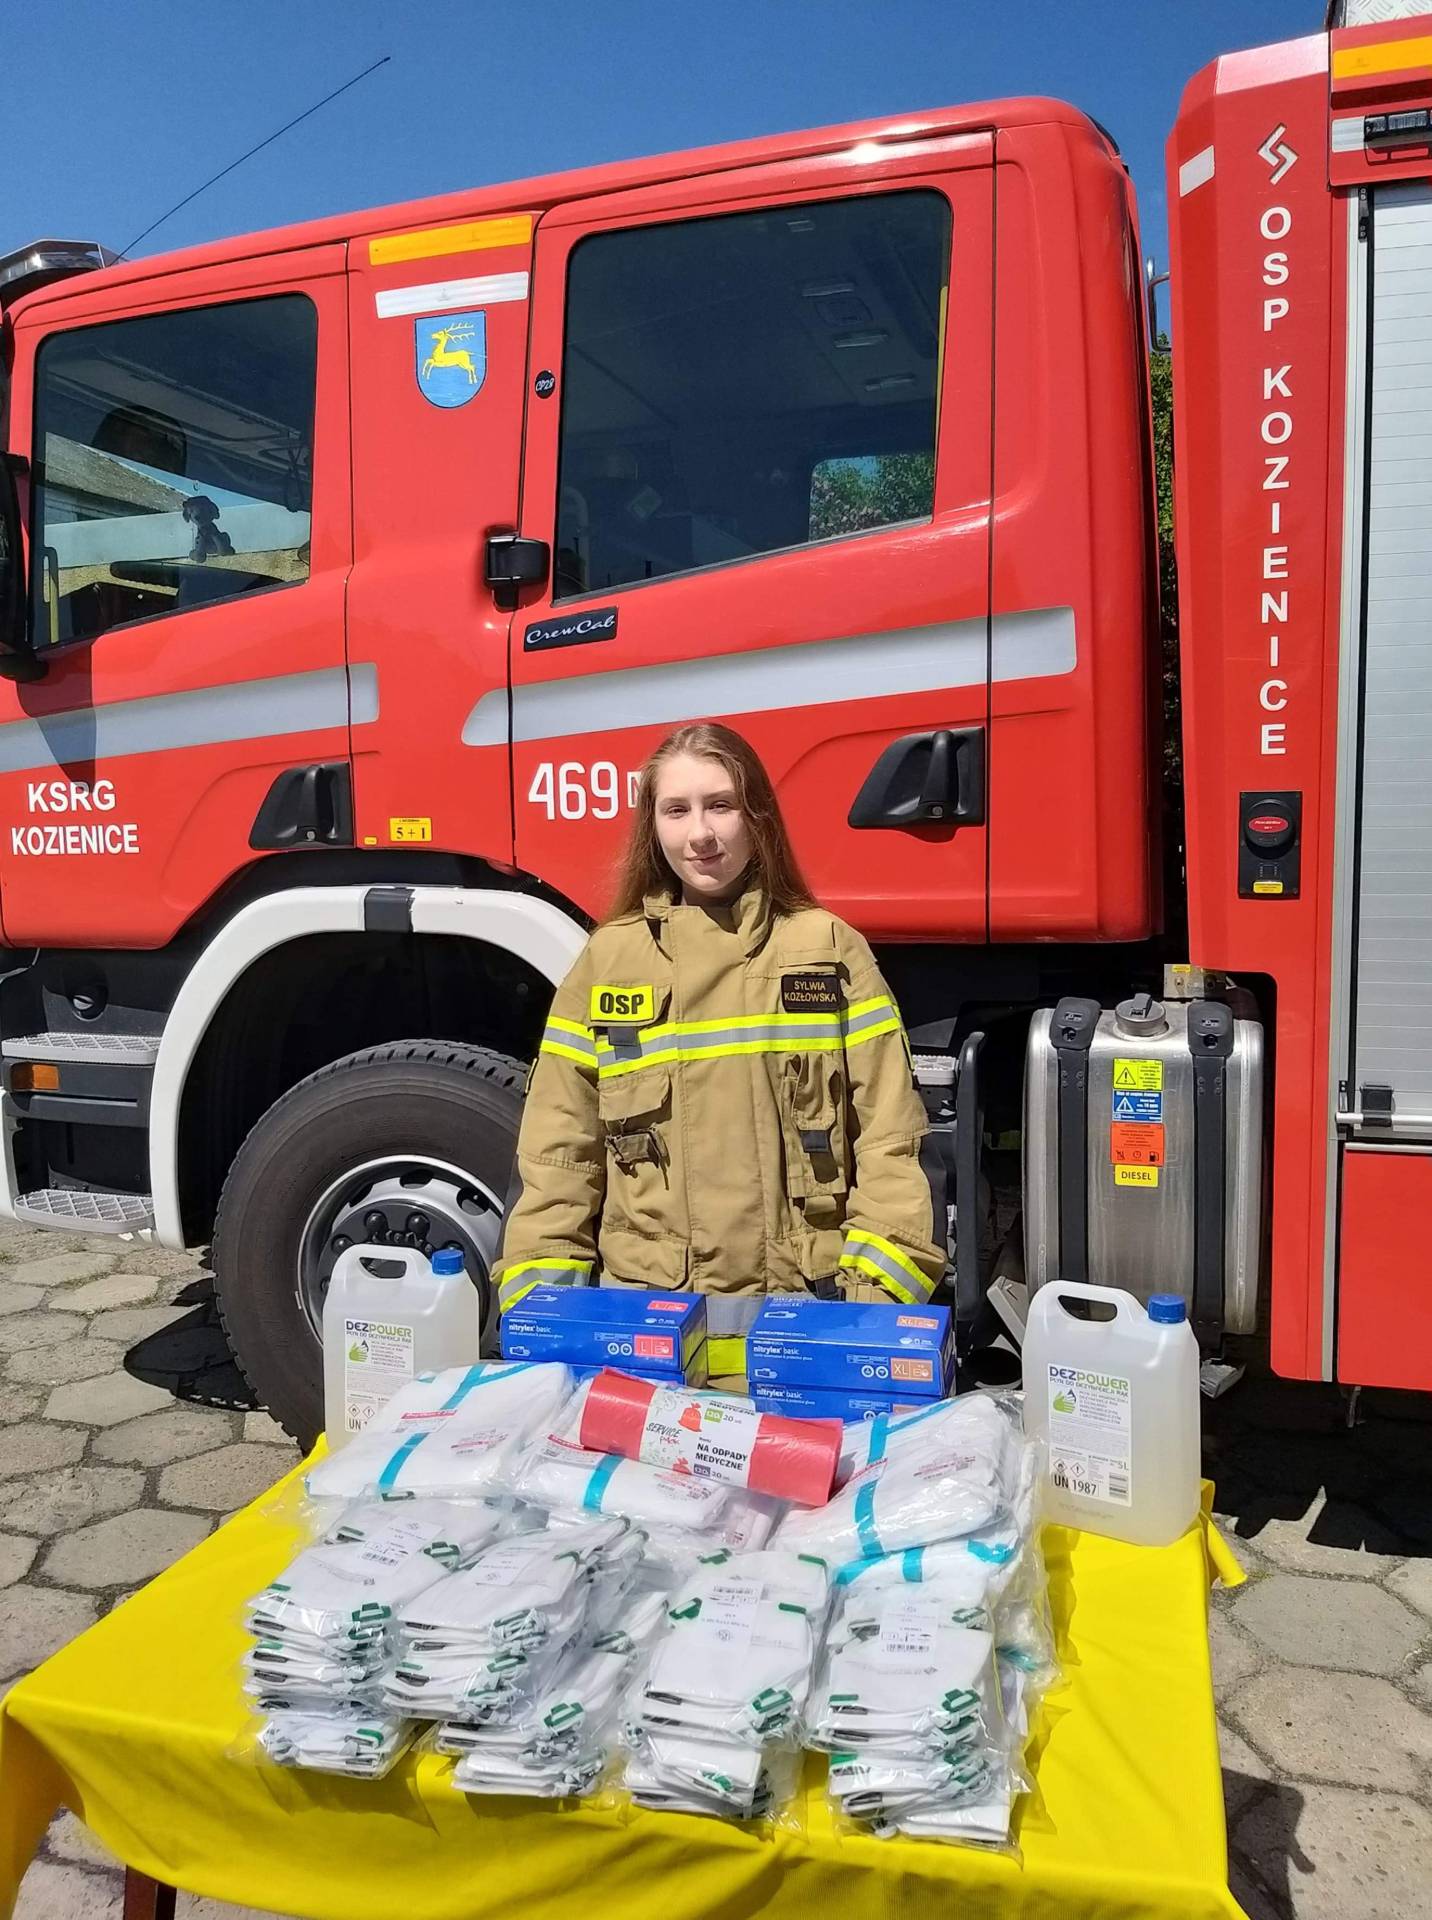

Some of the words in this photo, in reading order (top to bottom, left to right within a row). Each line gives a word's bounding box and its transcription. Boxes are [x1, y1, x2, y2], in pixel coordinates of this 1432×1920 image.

[1259, 206, 1292, 332] OSP
[1258, 365, 1293, 756] KOZIENICE
[526, 615, 615, 643] CrewCab
[28, 780, 116, 812] KSRG
[11, 824, 139, 855] KOZIENICE
[794, 981, 826, 991] SYLWIA
[600, 992, 644, 1015] OSP
[784, 992, 837, 1002] KOZŁOWSKA
[1121, 1171, 1152, 1181] DIESEL
[894, 1364, 908, 1375] XL
[646, 1422, 682, 1438] SERVICE
[695, 1452, 744, 1470] MEDYCZNE
[697, 1443, 709, 1452] NA
[712, 1447, 748, 1461] ODPADY
[1054, 1474, 1069, 1489] UN
[1073, 1480, 1097, 1496] 1987
